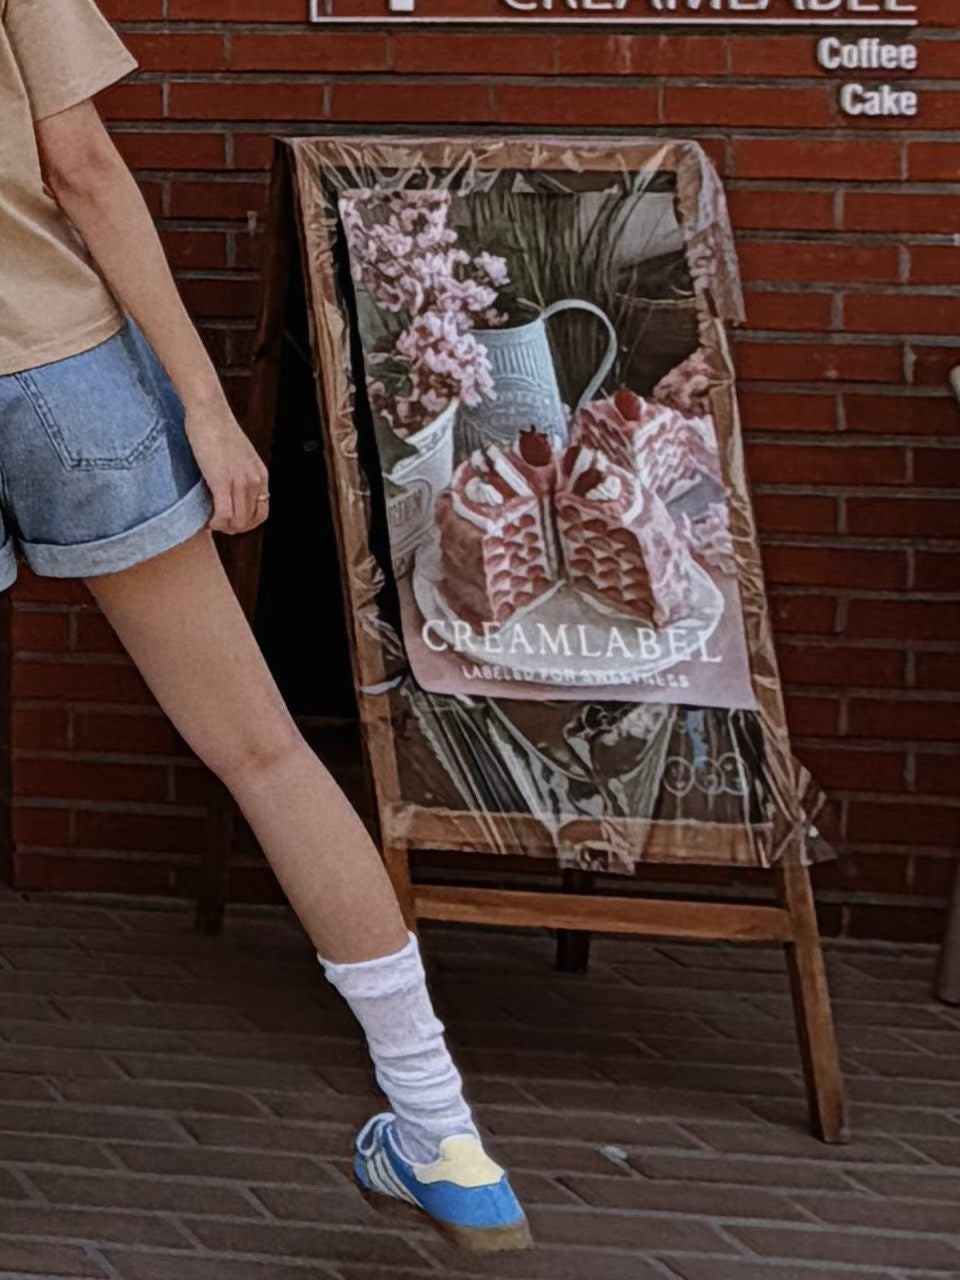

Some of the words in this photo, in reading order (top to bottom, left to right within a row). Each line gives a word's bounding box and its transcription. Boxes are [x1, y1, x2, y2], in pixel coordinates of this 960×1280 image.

[818, 36, 918, 70] Coffee
[840, 82, 918, 116] Cake
[421, 619, 724, 664] CREAMLABEL
